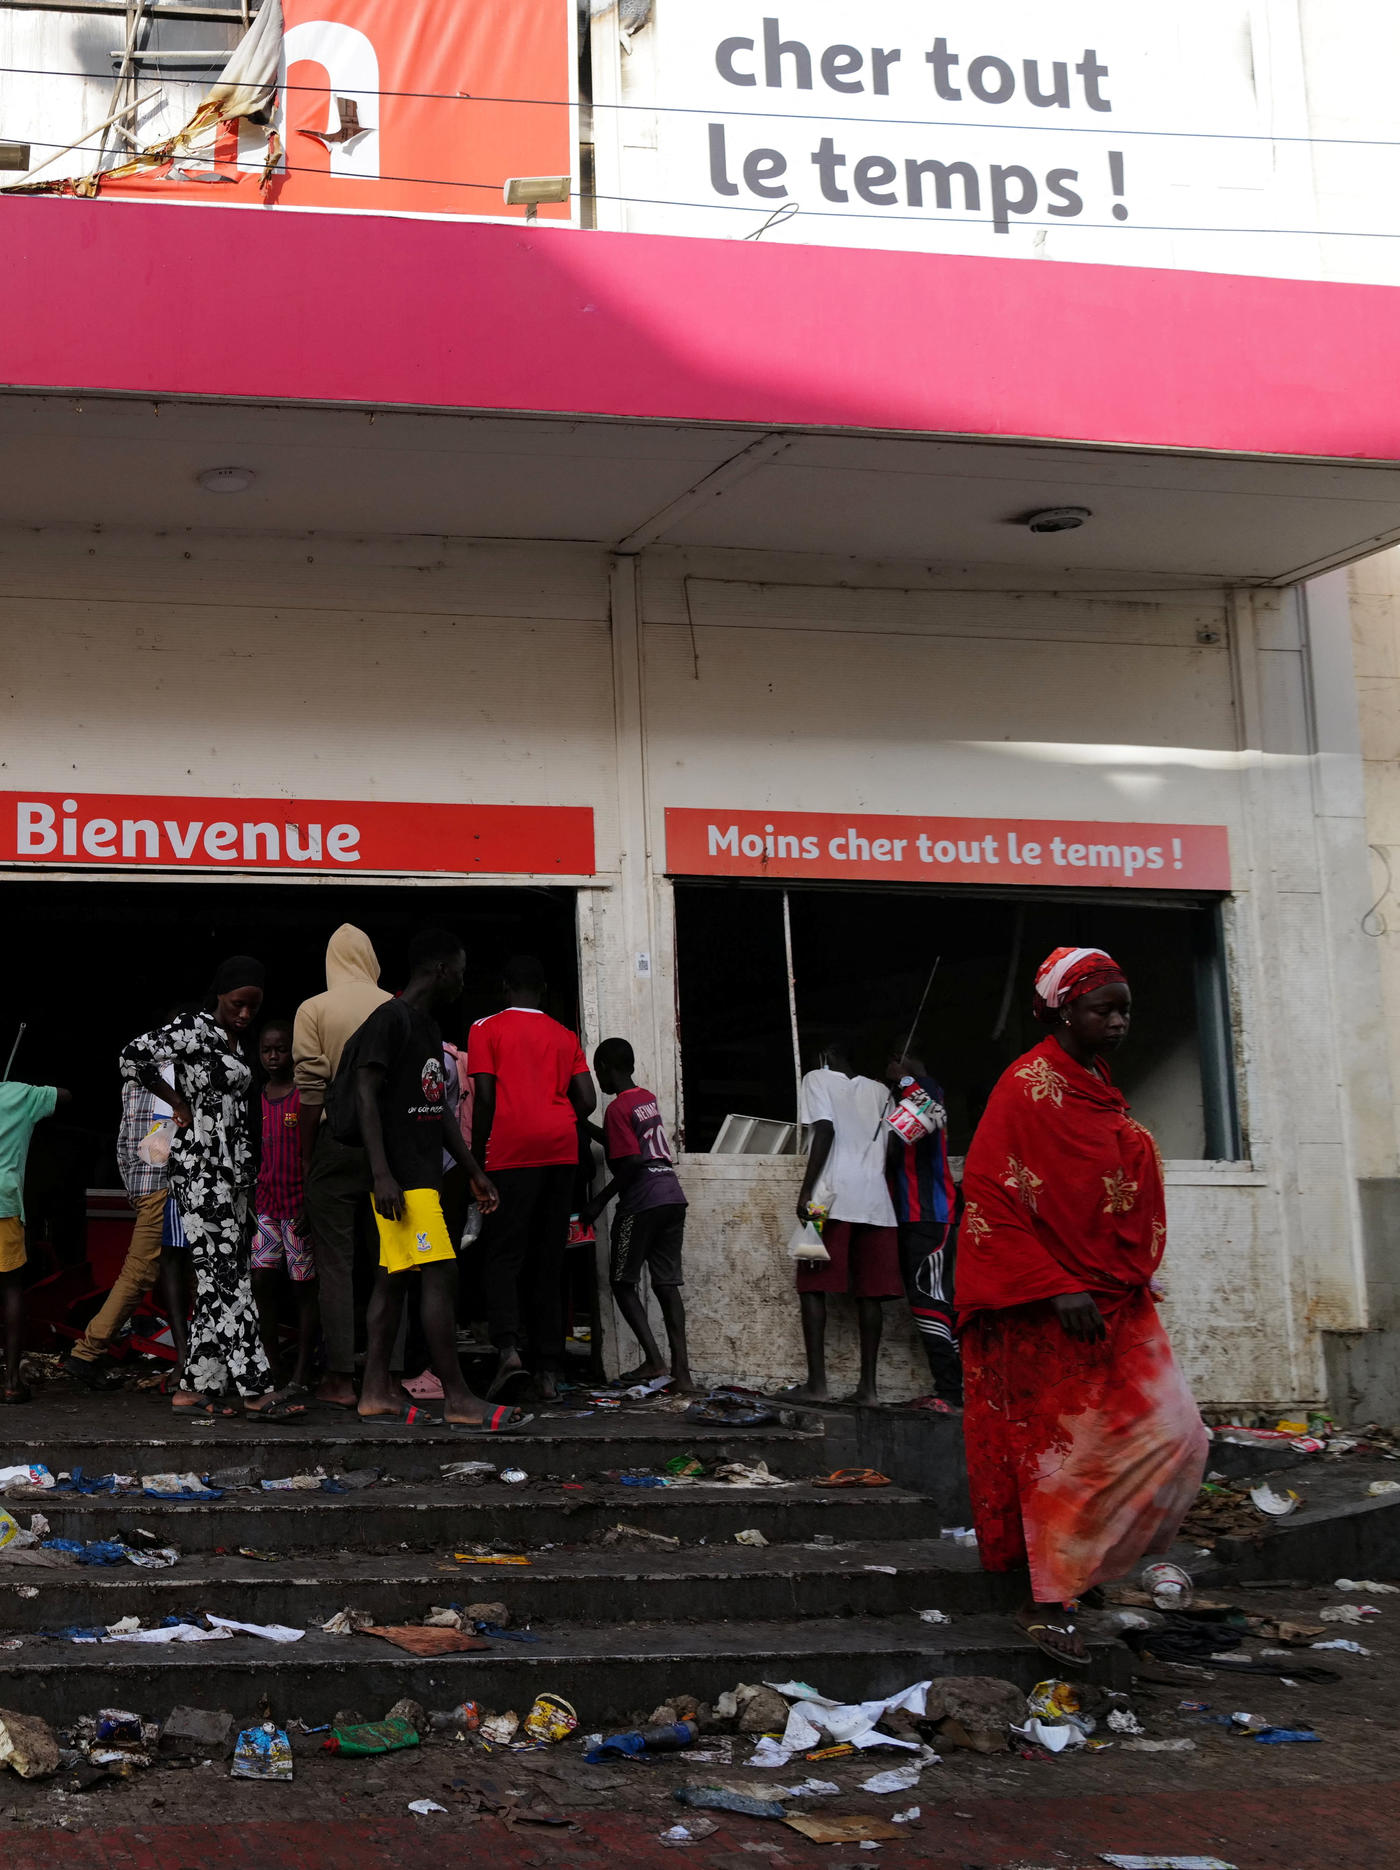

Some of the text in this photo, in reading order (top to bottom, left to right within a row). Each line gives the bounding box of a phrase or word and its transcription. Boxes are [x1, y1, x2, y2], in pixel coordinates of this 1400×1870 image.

[715, 17, 1113, 113] cher tout
[708, 123, 789, 199] le
[811, 136, 1084, 234] temps
[16, 799, 361, 862] Bienvenue
[707, 824, 820, 860] Moins
[828, 828, 905, 863] cher
[916, 833, 998, 865] tout
[1007, 832, 1042, 866] le
[1050, 837, 1164, 877] temps
